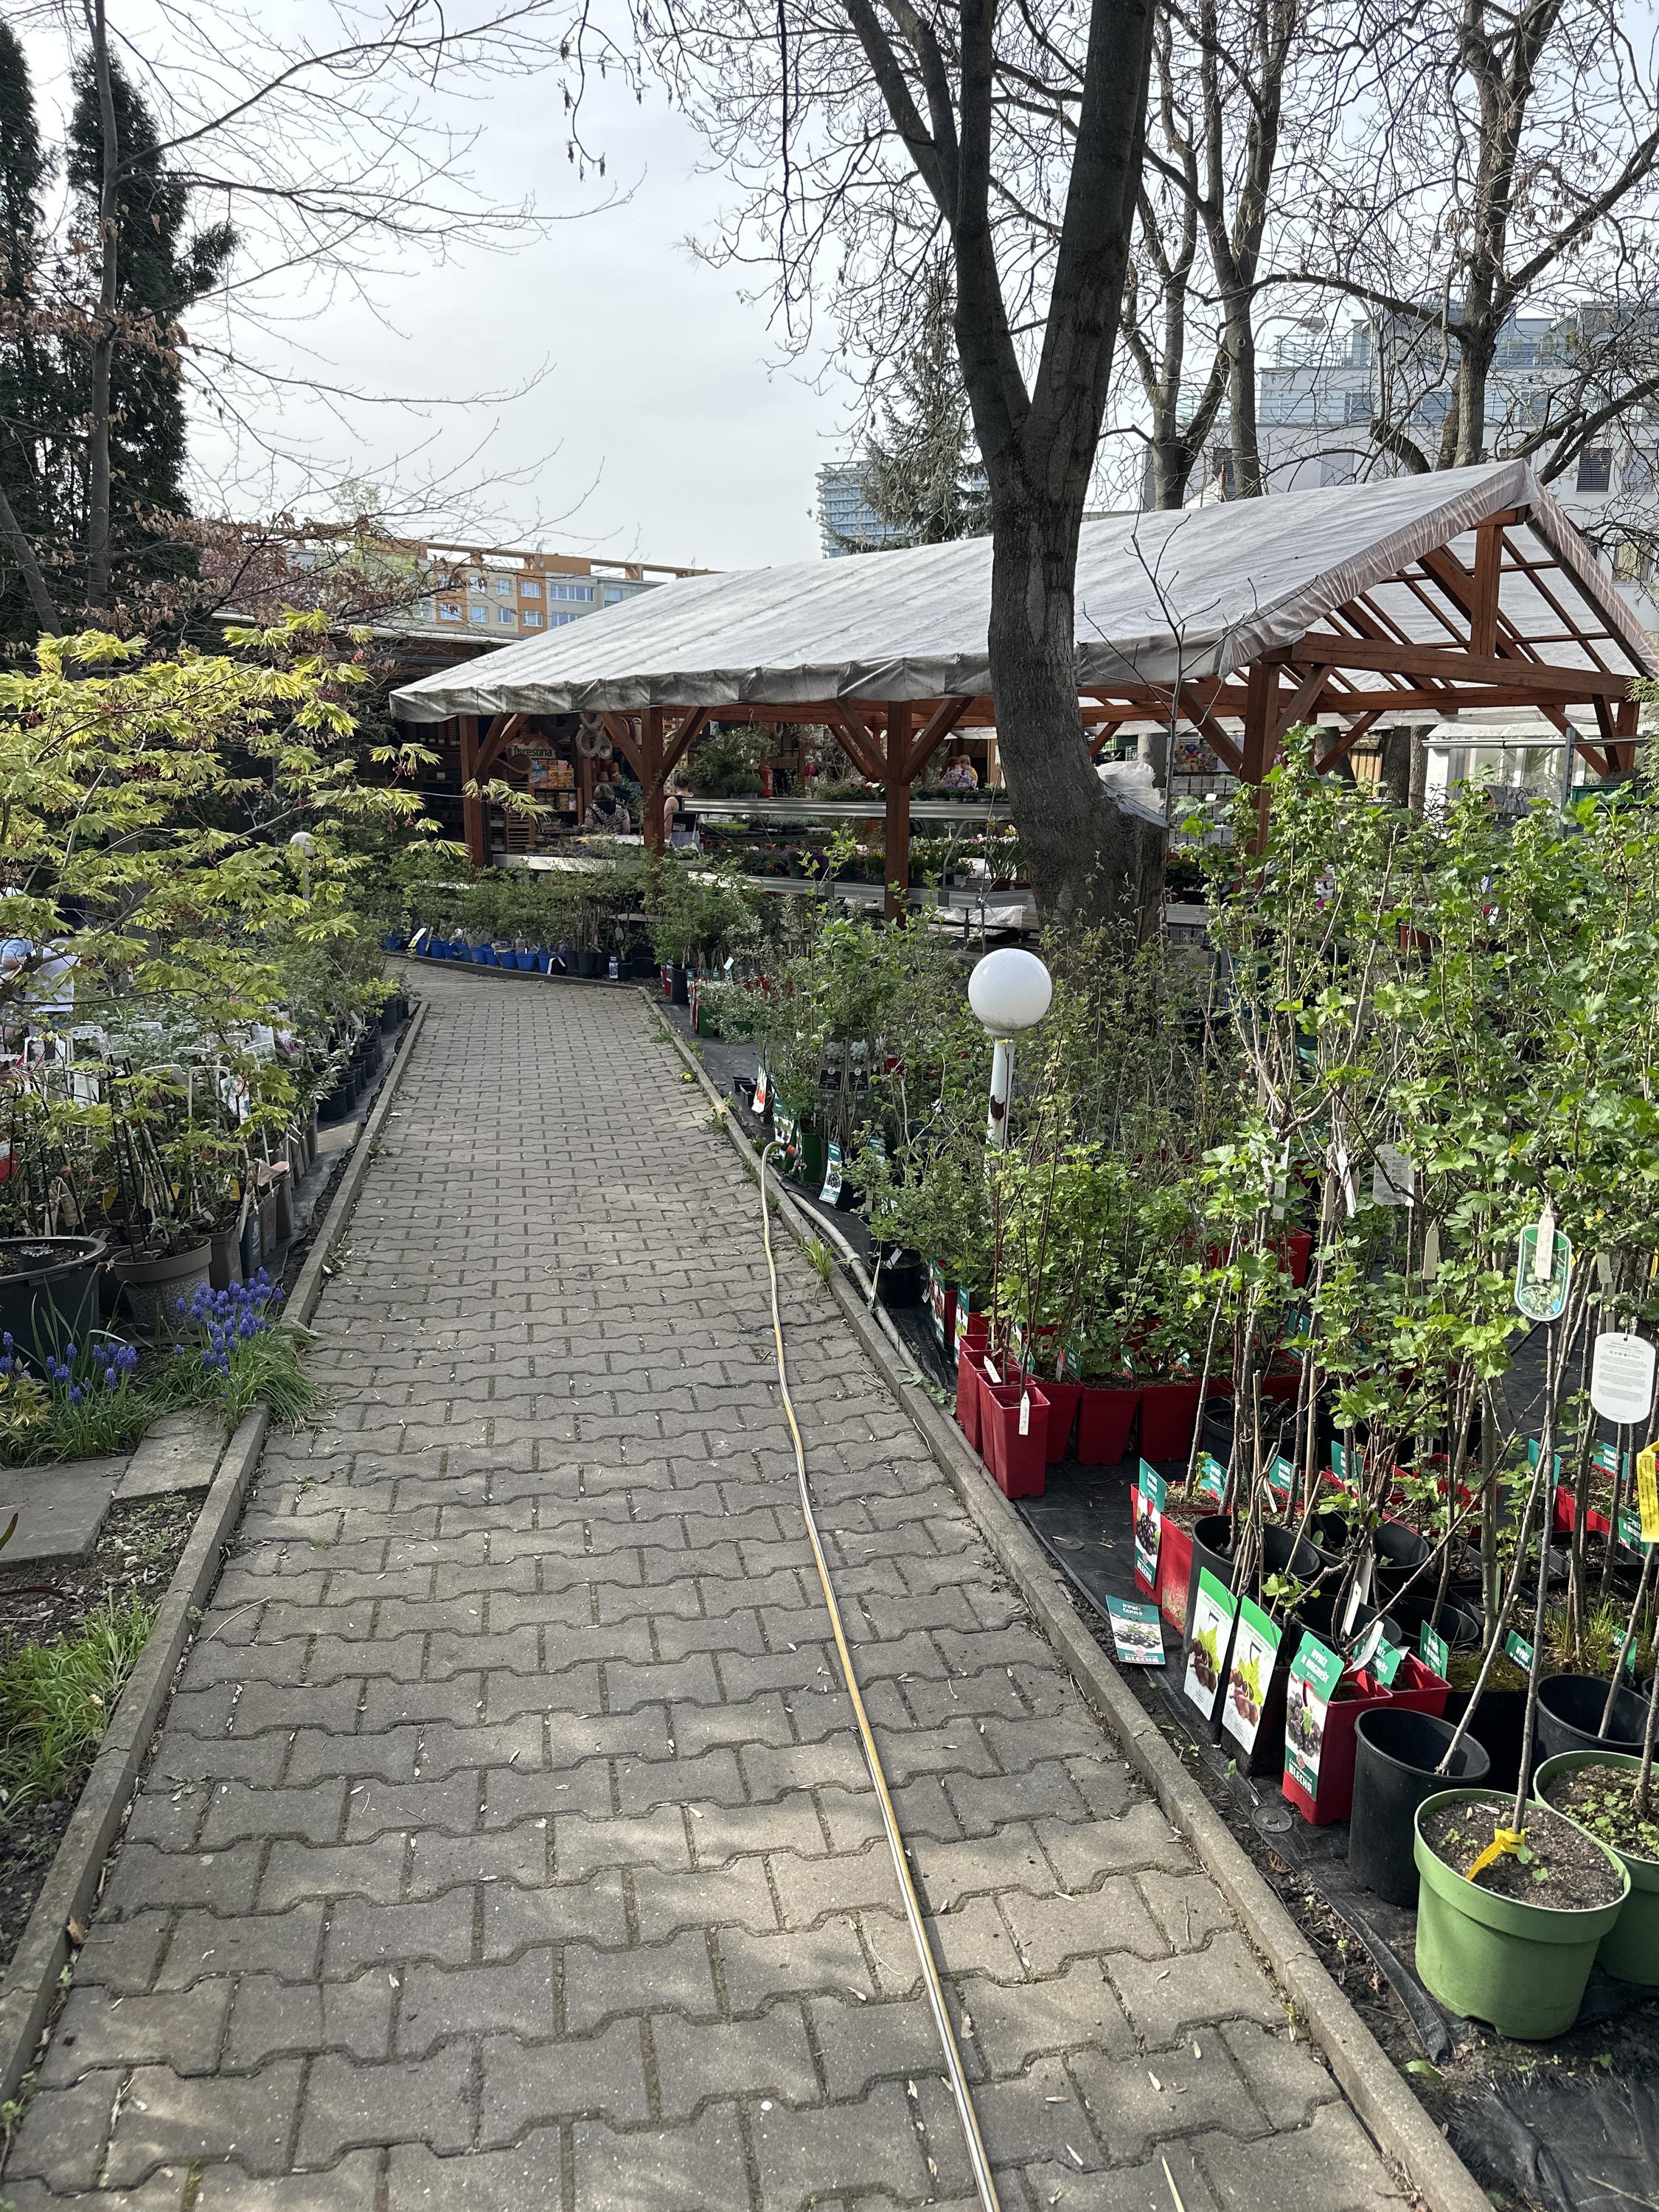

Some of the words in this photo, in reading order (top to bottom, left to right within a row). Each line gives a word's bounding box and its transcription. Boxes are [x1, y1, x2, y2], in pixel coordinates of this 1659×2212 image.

[1310, 1647, 1329, 1668] RYBÍZ
[1306, 1670, 1317, 1685] JOSTA
[1288, 1761, 1312, 1795] BLECHA
